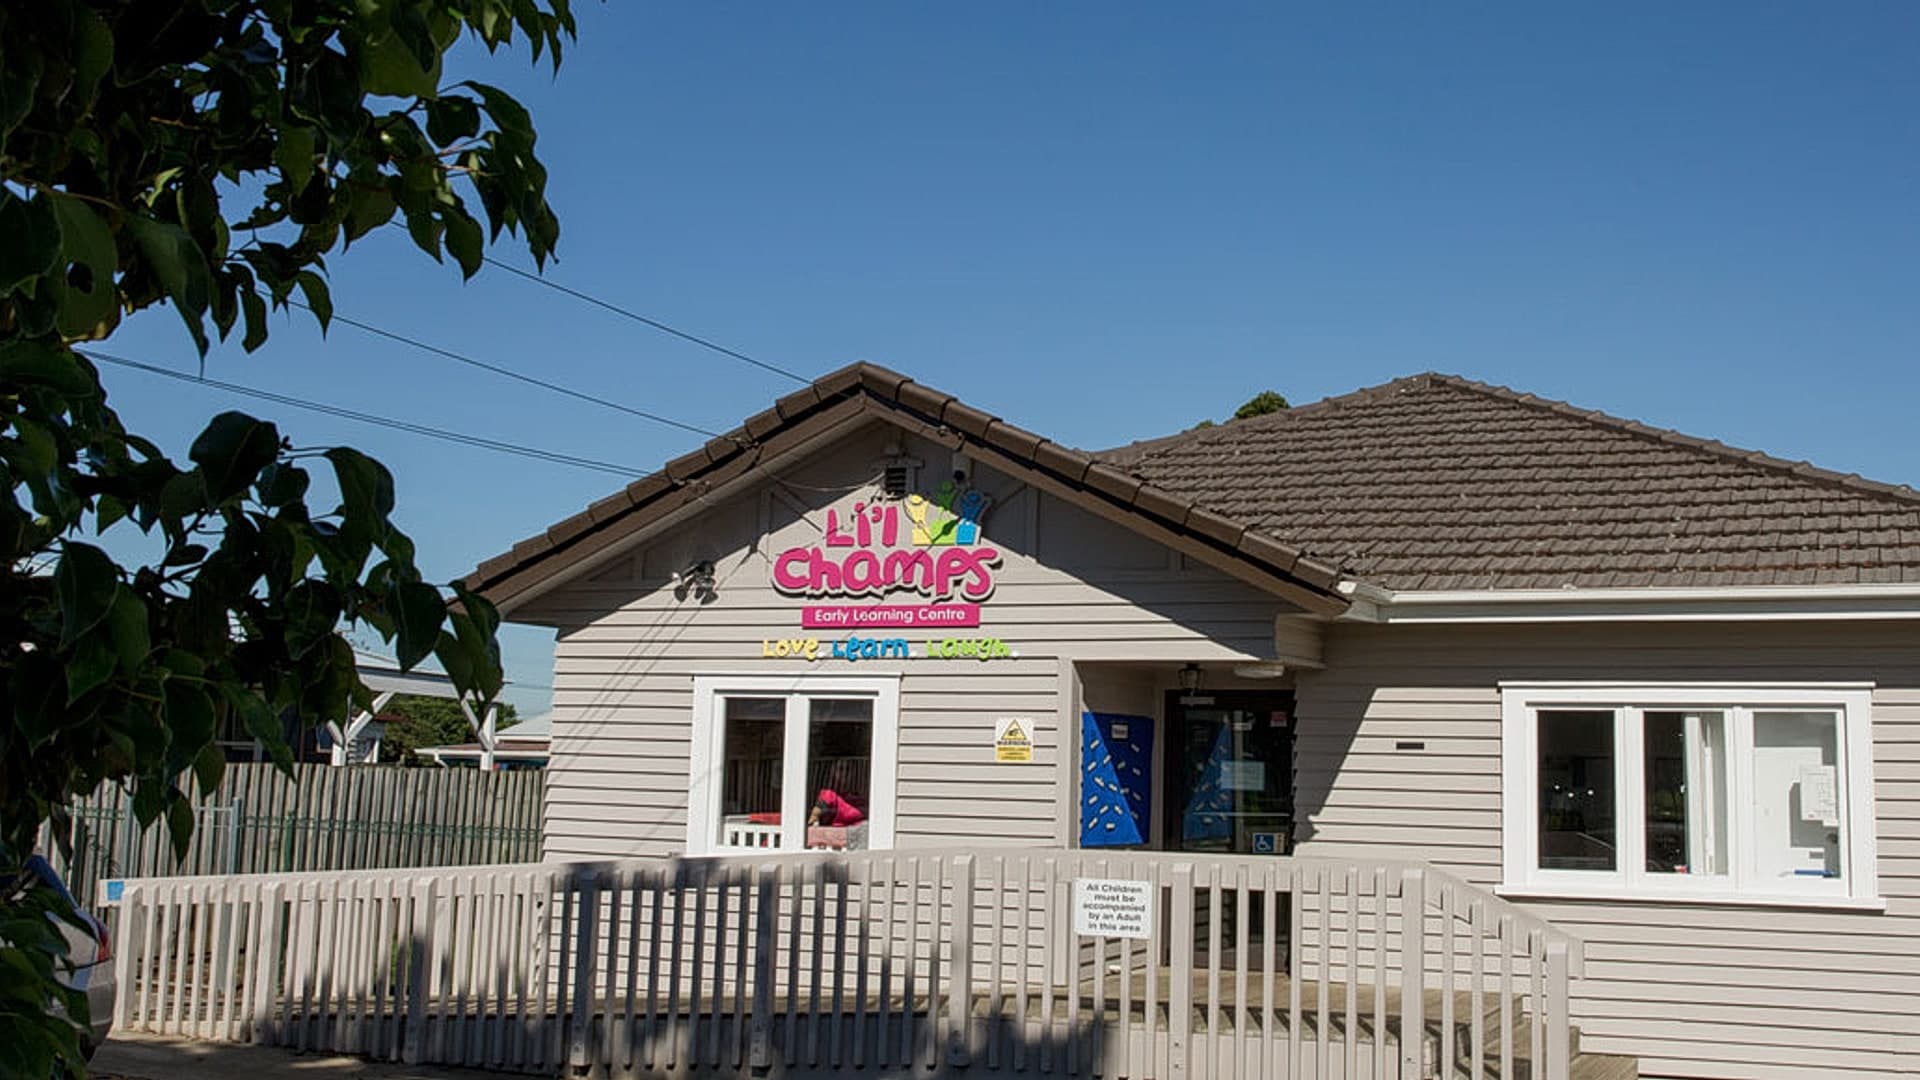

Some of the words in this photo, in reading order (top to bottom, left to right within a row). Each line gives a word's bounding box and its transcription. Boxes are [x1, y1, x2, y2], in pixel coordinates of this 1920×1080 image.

[814, 608, 849, 624] Early
[853, 608, 914, 624] Learning
[918, 607, 966, 621] Centre
[1086, 883, 1099, 892] All
[1101, 884, 1143, 894] Children
[1094, 894, 1120, 902] must
[1122, 894, 1137, 903] be
[1083, 902, 1146, 912] accompanied
[1088, 911, 1100, 921] by
[1100, 922, 1117, 931] this
